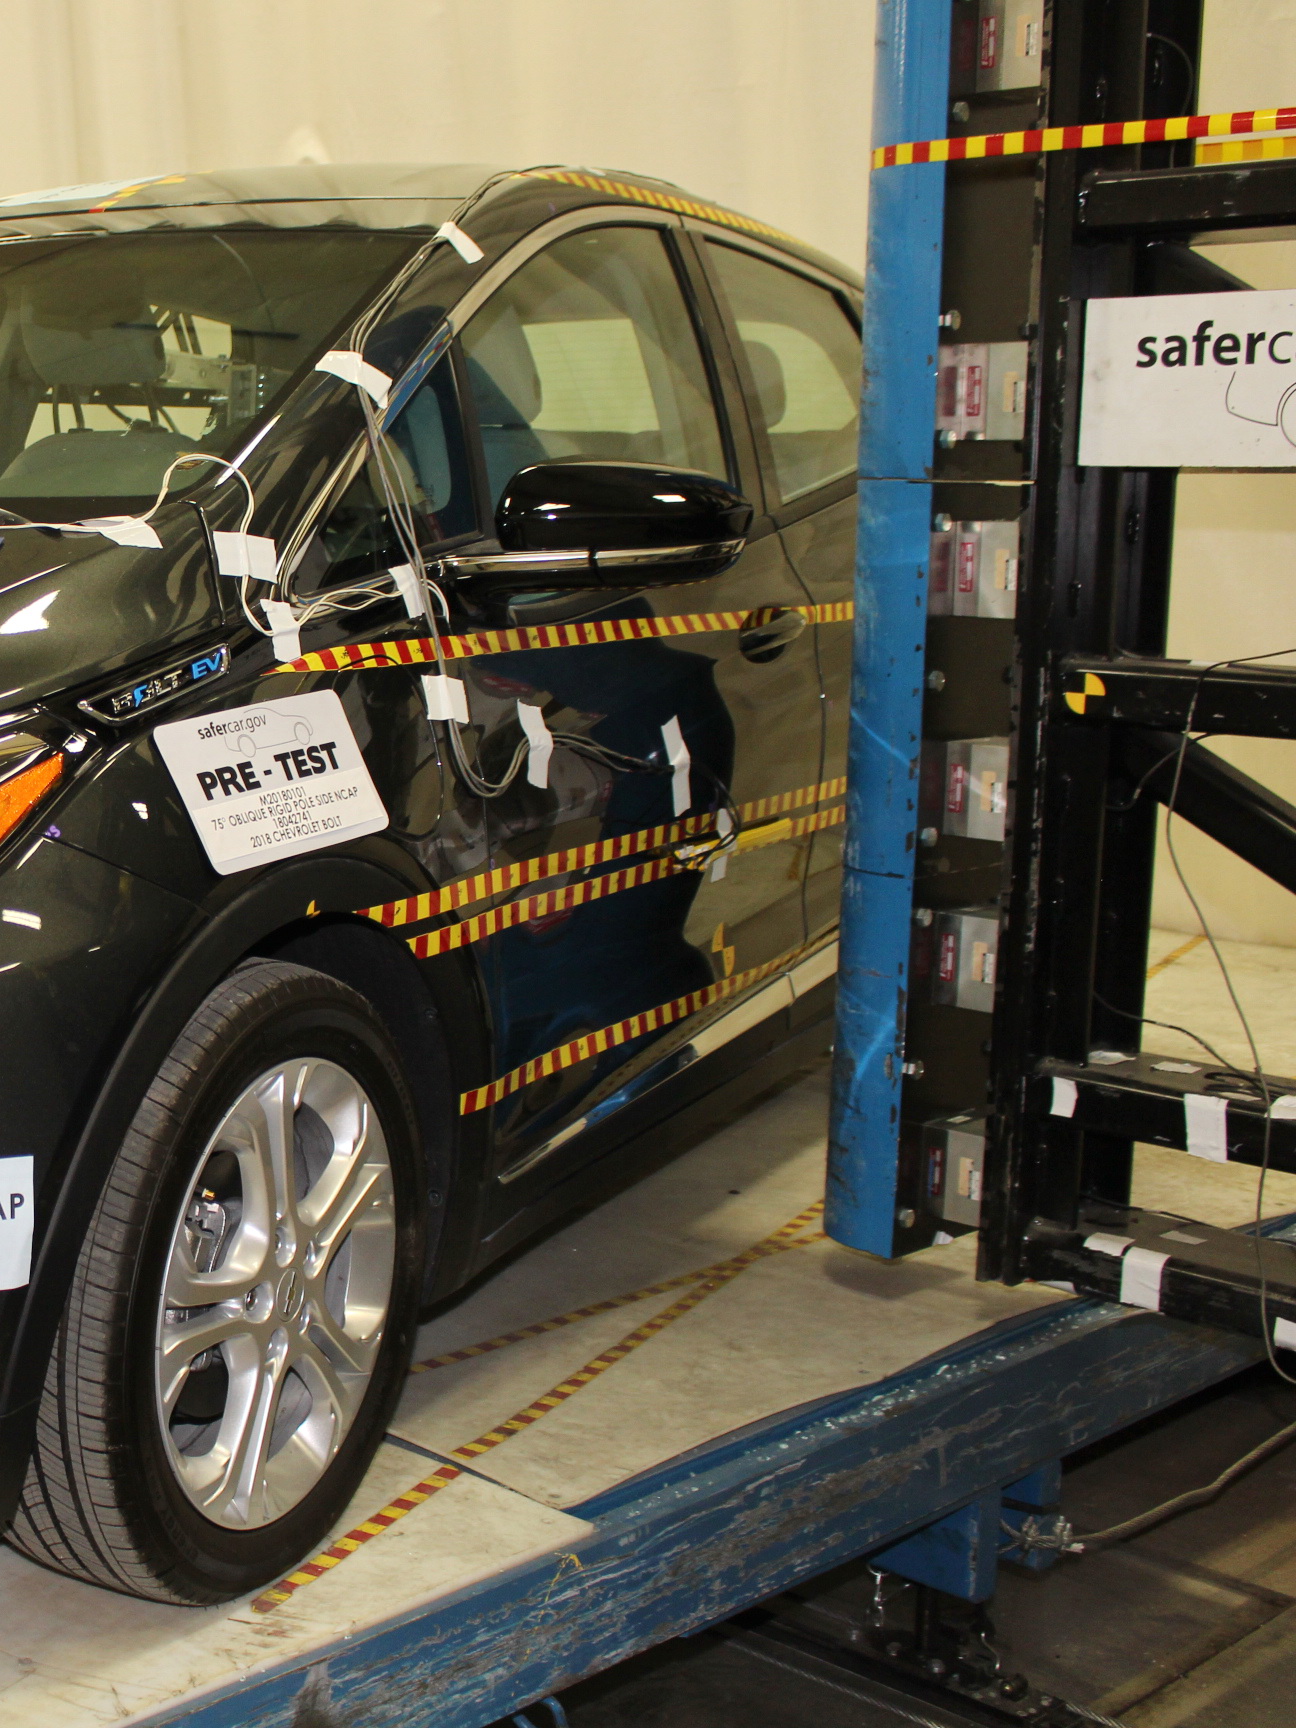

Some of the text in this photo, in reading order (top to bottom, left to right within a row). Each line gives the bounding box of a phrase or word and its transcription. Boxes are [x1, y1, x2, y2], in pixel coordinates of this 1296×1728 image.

[192, 653, 221, 679] EV
[197, 714, 266, 740] safercar.gov
[196, 760, 262, 801] PRE
[273, 741, 340, 781] TEST
[228, 807, 267, 827] OBLIQUE
[267, 802, 293, 820] RIGID
[294, 796, 315, 811] POLE
[315, 792, 333, 806] SIDE
[334, 786, 358, 801] NCAP
[259, 786, 306, 806] M20180101
[250, 815, 343, 848] 2018 CHEVROLET BOLT
[273, 810, 312, 829] 18042741
